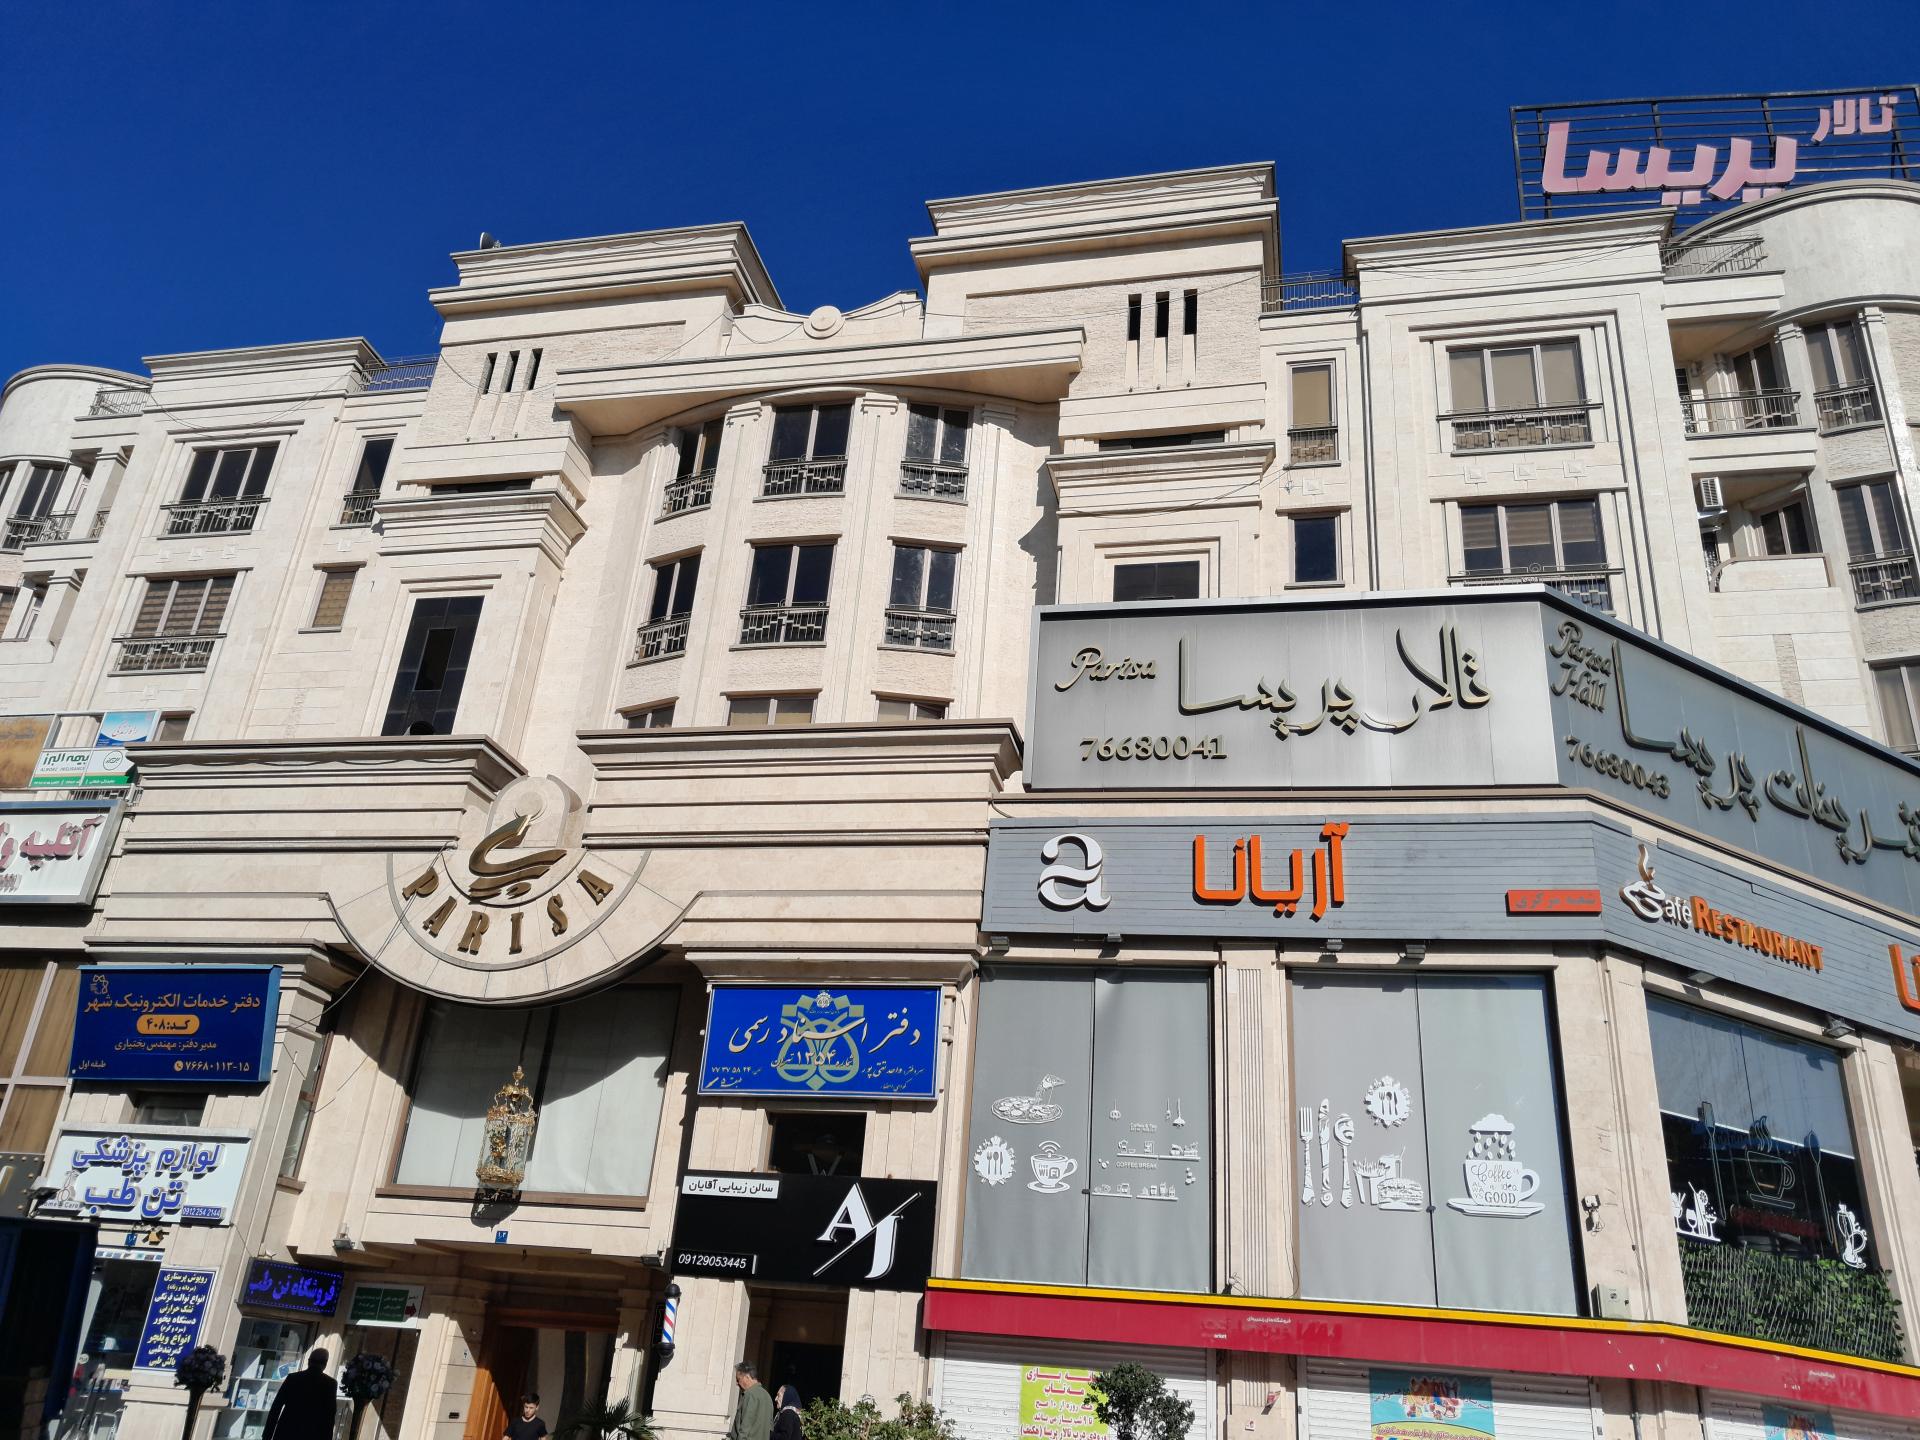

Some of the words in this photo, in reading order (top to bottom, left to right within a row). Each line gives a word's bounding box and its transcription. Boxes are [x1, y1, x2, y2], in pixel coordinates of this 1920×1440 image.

[1811, 95, 1898, 144] تالار
[1542, 121, 1798, 206] پریسا
[1550, 622, 1612, 677] Parisa
[1055, 646, 1158, 692] Parisa
[1361, 621, 1493, 735] تالار
[1178, 632, 1361, 740] پریسا
[1551, 663, 1607, 713] Hall
[1079, 735, 1228, 761] 76680041
[1564, 735, 1671, 800] 76680043
[1193, 822, 1349, 920] آریانا
[402, 867, 614, 955] PARISA
[84, 995, 113, 1012] شهر
[115, 992, 181, 1013] الکترونیک
[183, 993, 229, 1009] خدمات
[230, 992, 261, 1013] دفتر
[728, 1015, 771, 1053] رسمی
[777, 1013, 868, 1044] اسناد
[868, 1006, 921, 1053] دفتر
[114, 1037, 146, 1051] بختیاری
[147, 1039, 177, 1051] مهندس
[199, 1039, 217, 1051] مدیر
[79, 1060, 91, 1070] اول
[797, 1050, 836, 1067] ۱۳۵۴
[72, 1135, 150, 1176] پزشکی
[156, 1143, 221, 1173] لوازم
[84, 1177, 137, 1216] طب
[688, 1179, 718, 1192] آقایان
[719, 1181, 748, 1194] زیبایی
[749, 1183, 774, 1194] سالن
[140, 1180, 184, 1218] تن
[1485, 1191, 1516, 1204] GOOD
[678, 1253, 747, 1269] 09129053445
[190, 1294, 206, 1305] انواع
[291, 1277, 336, 1307] فروشگاه
[153, 1314, 171, 1325] بخور
[172, 1315, 196, 1325] دستگاه
[170, 1334, 191, 1345] انواع
[1026, 1368, 1062, 1383] بازی
